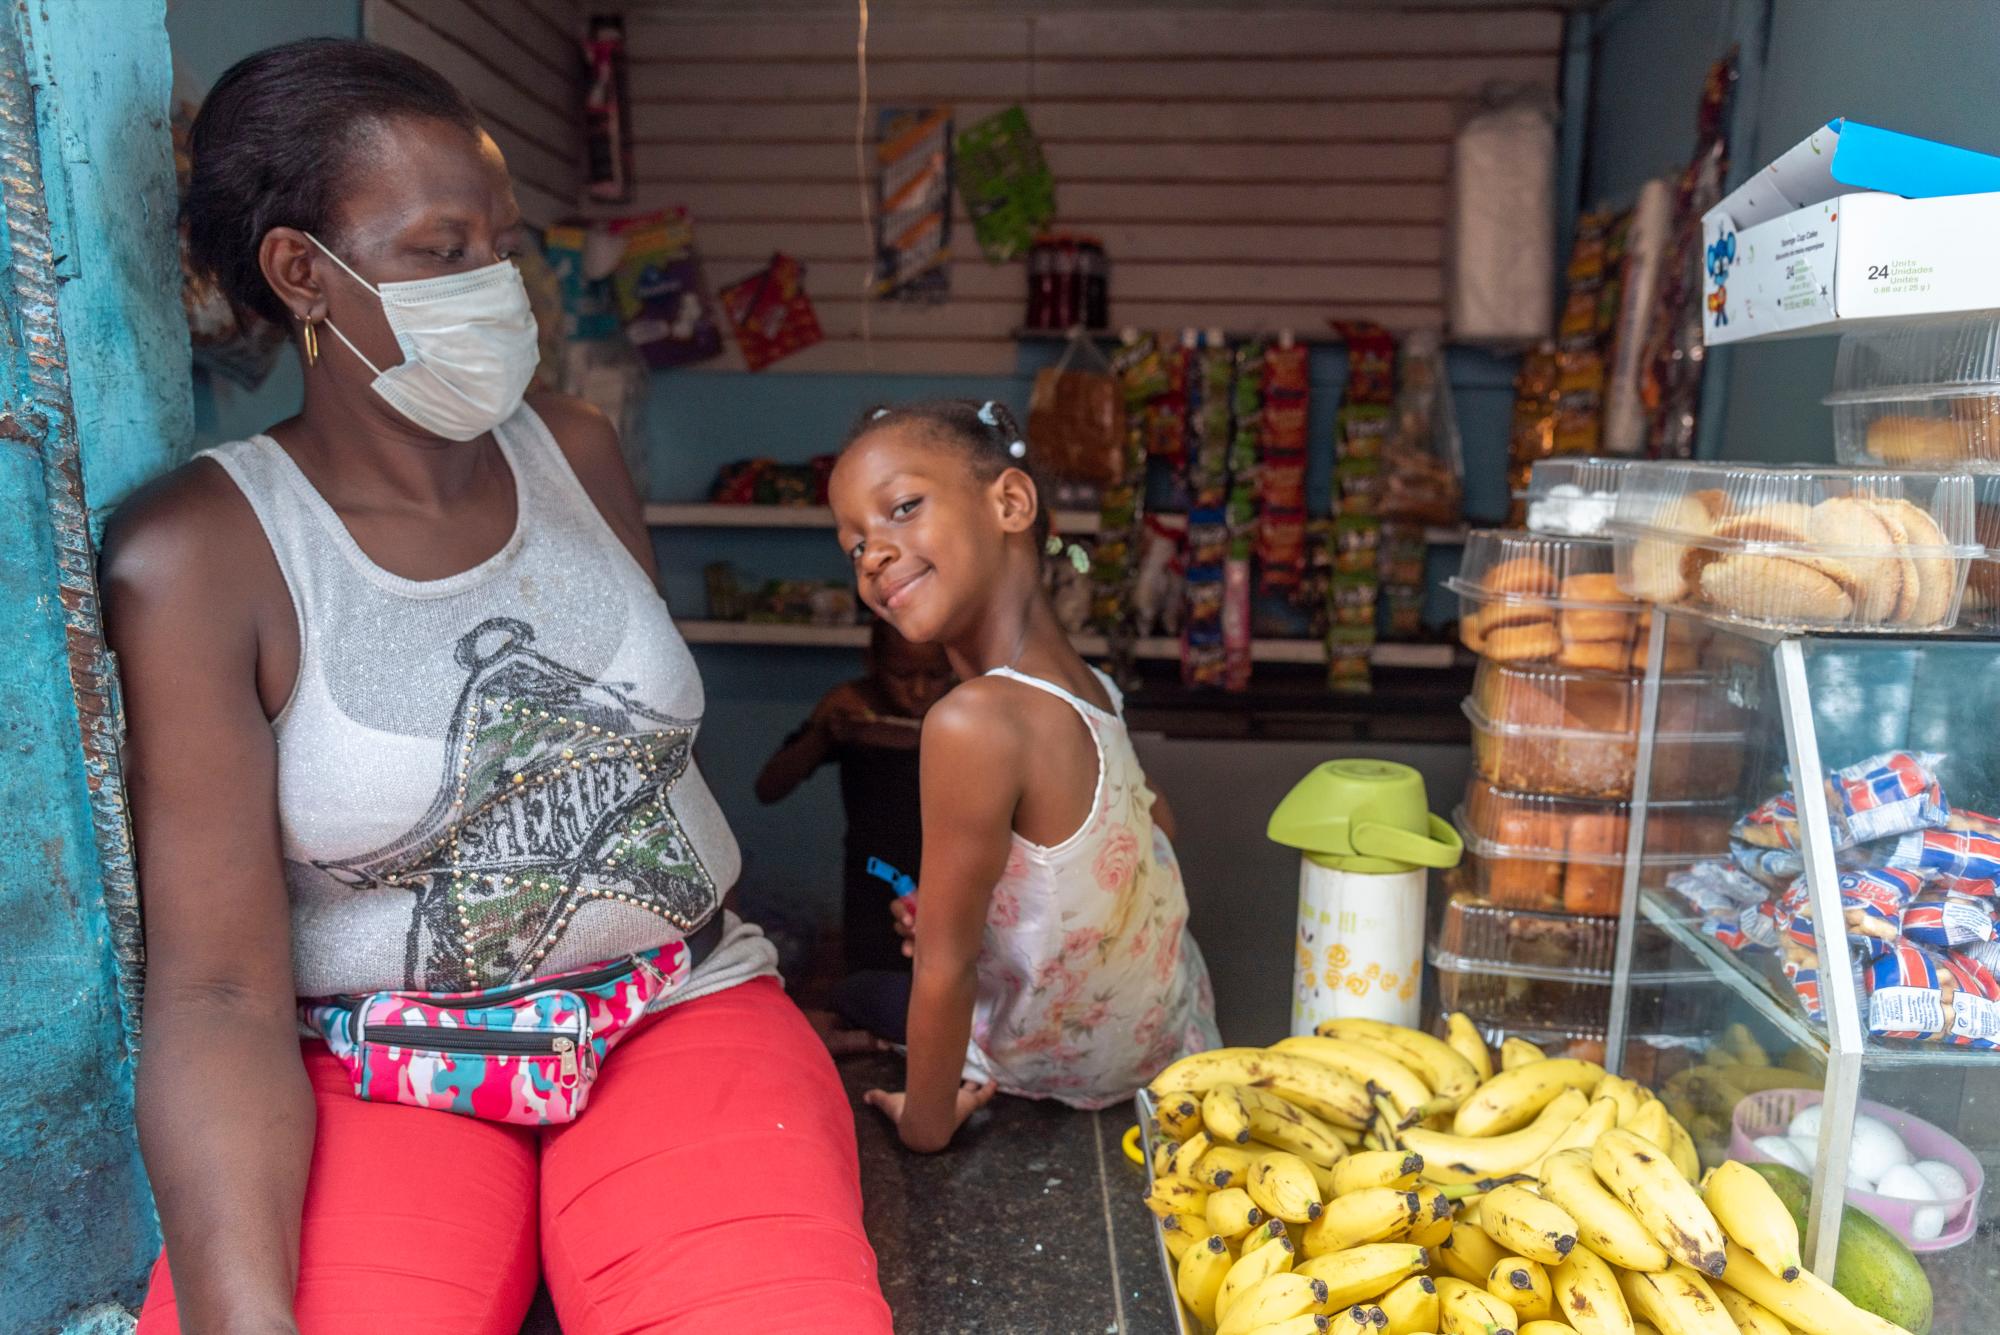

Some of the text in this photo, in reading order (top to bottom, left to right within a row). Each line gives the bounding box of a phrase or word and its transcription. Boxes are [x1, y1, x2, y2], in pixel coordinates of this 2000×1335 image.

[1891, 260, 1918, 268] Units
[1786, 265, 1795, 280] 24
[1868, 265, 1889, 280] 24
[1891, 266, 1934, 276] Unidades
